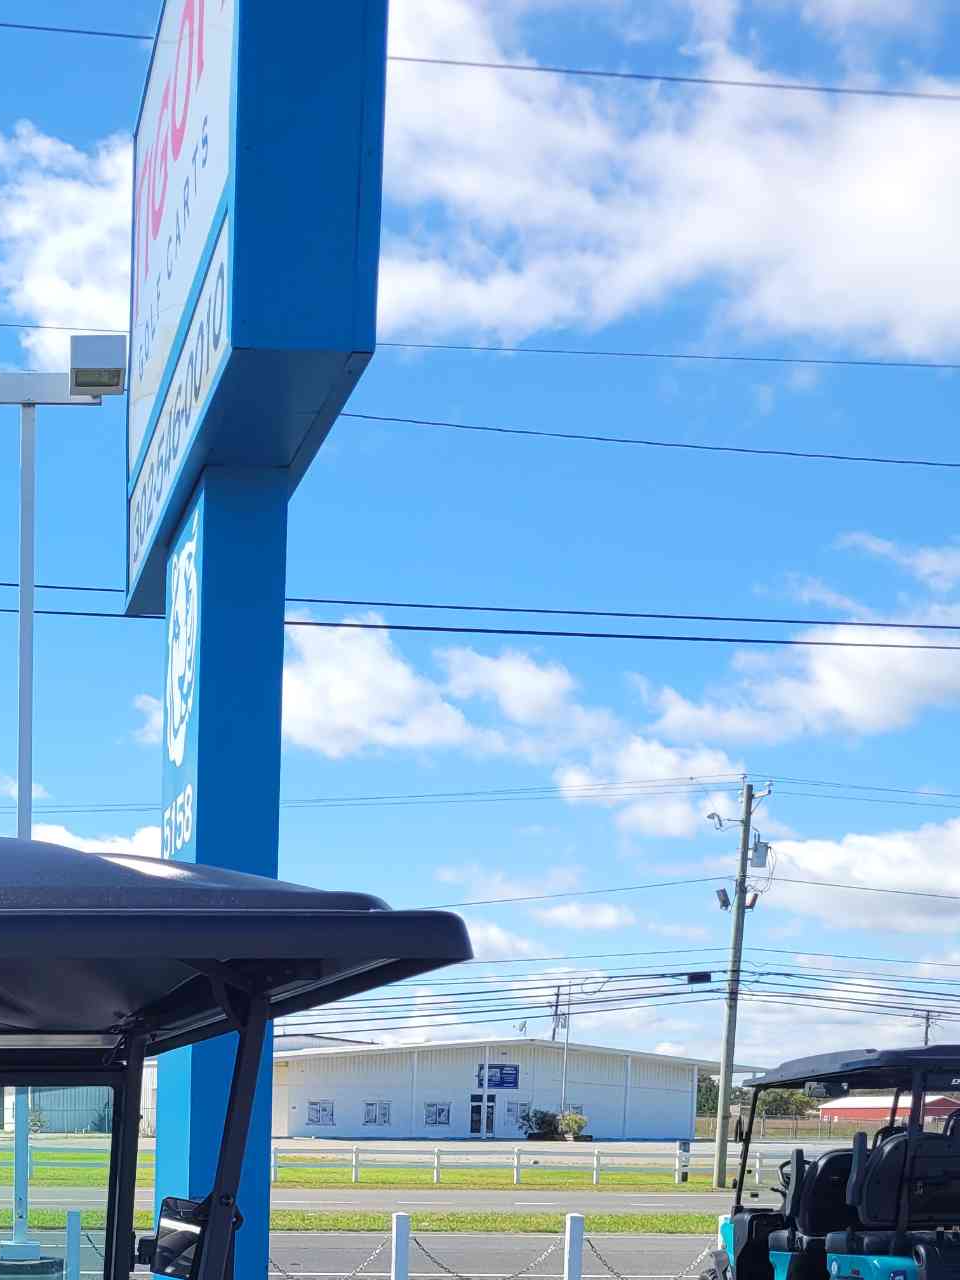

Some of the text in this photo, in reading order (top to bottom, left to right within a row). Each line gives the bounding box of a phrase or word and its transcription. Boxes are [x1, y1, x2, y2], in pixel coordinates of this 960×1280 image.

[138, 114, 208, 381] GOLF CARTS
[162, 783, 193, 860] 5158
